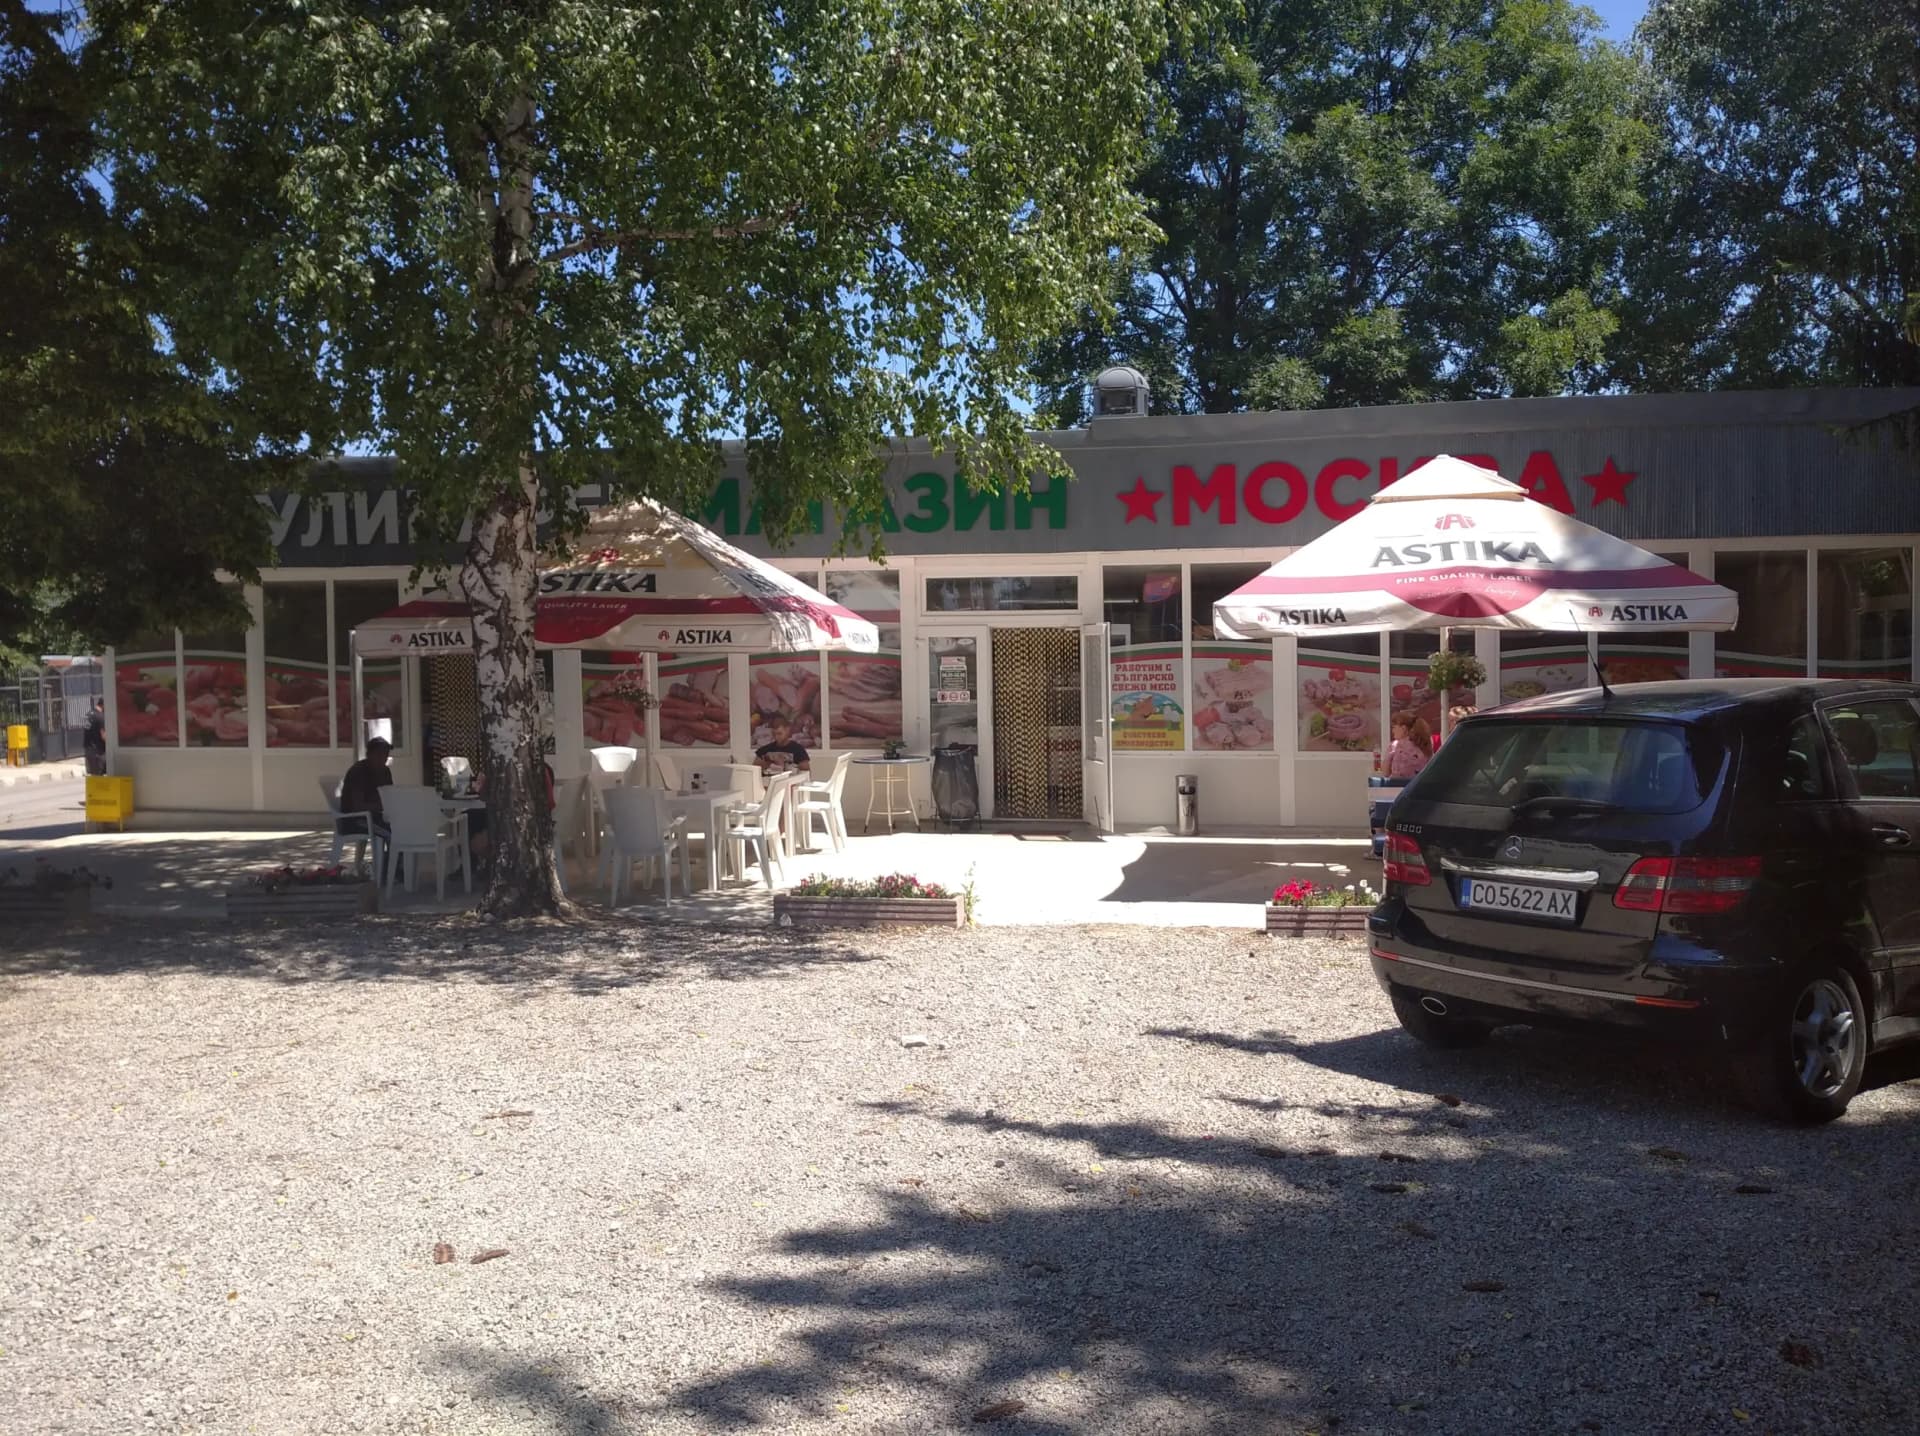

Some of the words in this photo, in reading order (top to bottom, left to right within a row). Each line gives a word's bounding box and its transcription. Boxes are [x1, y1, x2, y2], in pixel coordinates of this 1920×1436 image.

[1370, 540, 1553, 568] ASTIKA
[540, 571, 657, 593] STIKA
[1396, 576, 1425, 585] FINE
[1429, 572, 1486, 582] QUALITY
[1490, 573, 1533, 583] LAGER
[1278, 607, 1347, 626] ASTIKA
[1611, 604, 1688, 621] ASTIKA
[408, 631, 465, 648] ASTIKA
[675, 629, 733, 645] ASTIKA
[1115, 663, 1163, 673] РАБОТИМ
[1111, 683, 1147, 692] СВЕЖО
[1150, 682, 1177, 691] МЕСО
